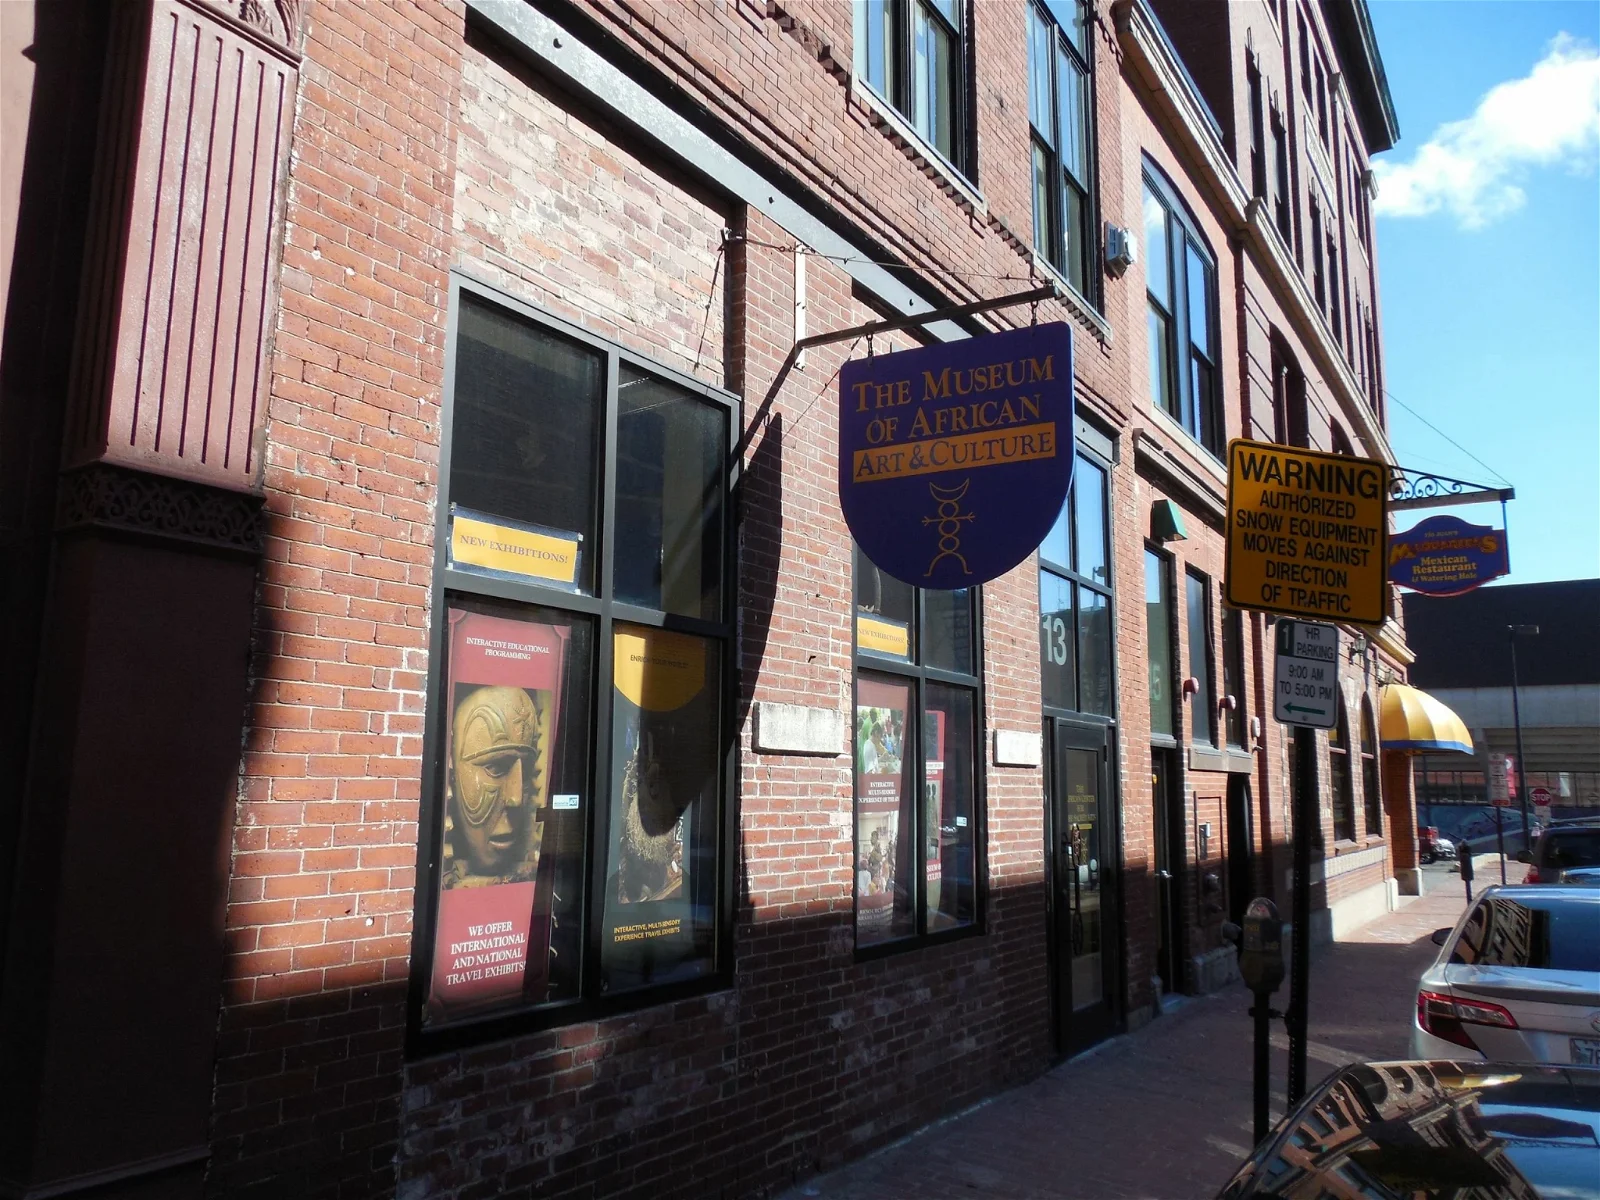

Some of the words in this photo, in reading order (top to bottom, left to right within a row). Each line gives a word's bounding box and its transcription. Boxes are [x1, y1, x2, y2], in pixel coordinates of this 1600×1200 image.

[852, 380, 912, 413] THE
[922, 355, 1055, 401] MUSEUM
[865, 416, 899, 444] OF
[908, 393, 1042, 438] AFRICAN
[856, 451, 905, 477] ART
[1239, 450, 1379, 500] WARNING
[1260, 490, 1356, 520] AUTHORIZED
[1236, 509, 1283, 533] SNOW
[1289, 517, 1378, 546] EQUIPMENT
[460, 535, 488, 547] NEW
[489, 541, 568, 563] EXHIBITIONS!
[1243, 532, 1297, 557] MOVES
[1304, 541, 1370, 567] AGAINST
[1420, 556, 1468, 566] Mexican
[1266, 560, 1348, 588] DIRECTION
[1412, 562, 1477, 574] Restaurant
[1261, 584, 1282, 603] OF
[1288, 587, 1352, 613] TRAFFIC
[466, 637, 507, 649] INTERACTIVE
[507, 641, 550, 654] EDUCATIONAL
[1042, 614, 1067, 666] 13
[1282, 625, 1290, 650] 1
[1306, 627, 1320, 640] HR
[485, 649, 531, 660] PROGRAMMING
[1297, 642, 1334, 660] PARKING
[1288, 665, 1307, 679] 9:00
[1311, 668, 1324, 681] AM
[1280, 681, 1292, 694] TO
[1295, 683, 1316, 698] 5:00
[1320, 687, 1333, 700] PM
[1532, 793, 1550, 801] STOP
[469, 925, 484, 936] WE
[485, 921, 512, 934] OFFER
[615, 932, 644, 942] EXPERIENCE
[451, 933, 525, 955] INTERNATIONAL
[452, 956, 475, 970] AND
[476, 948, 523, 966] NATIONAL
[446, 970, 484, 985] TRAVEL
[485, 961, 527, 978] EXHIBITS!
